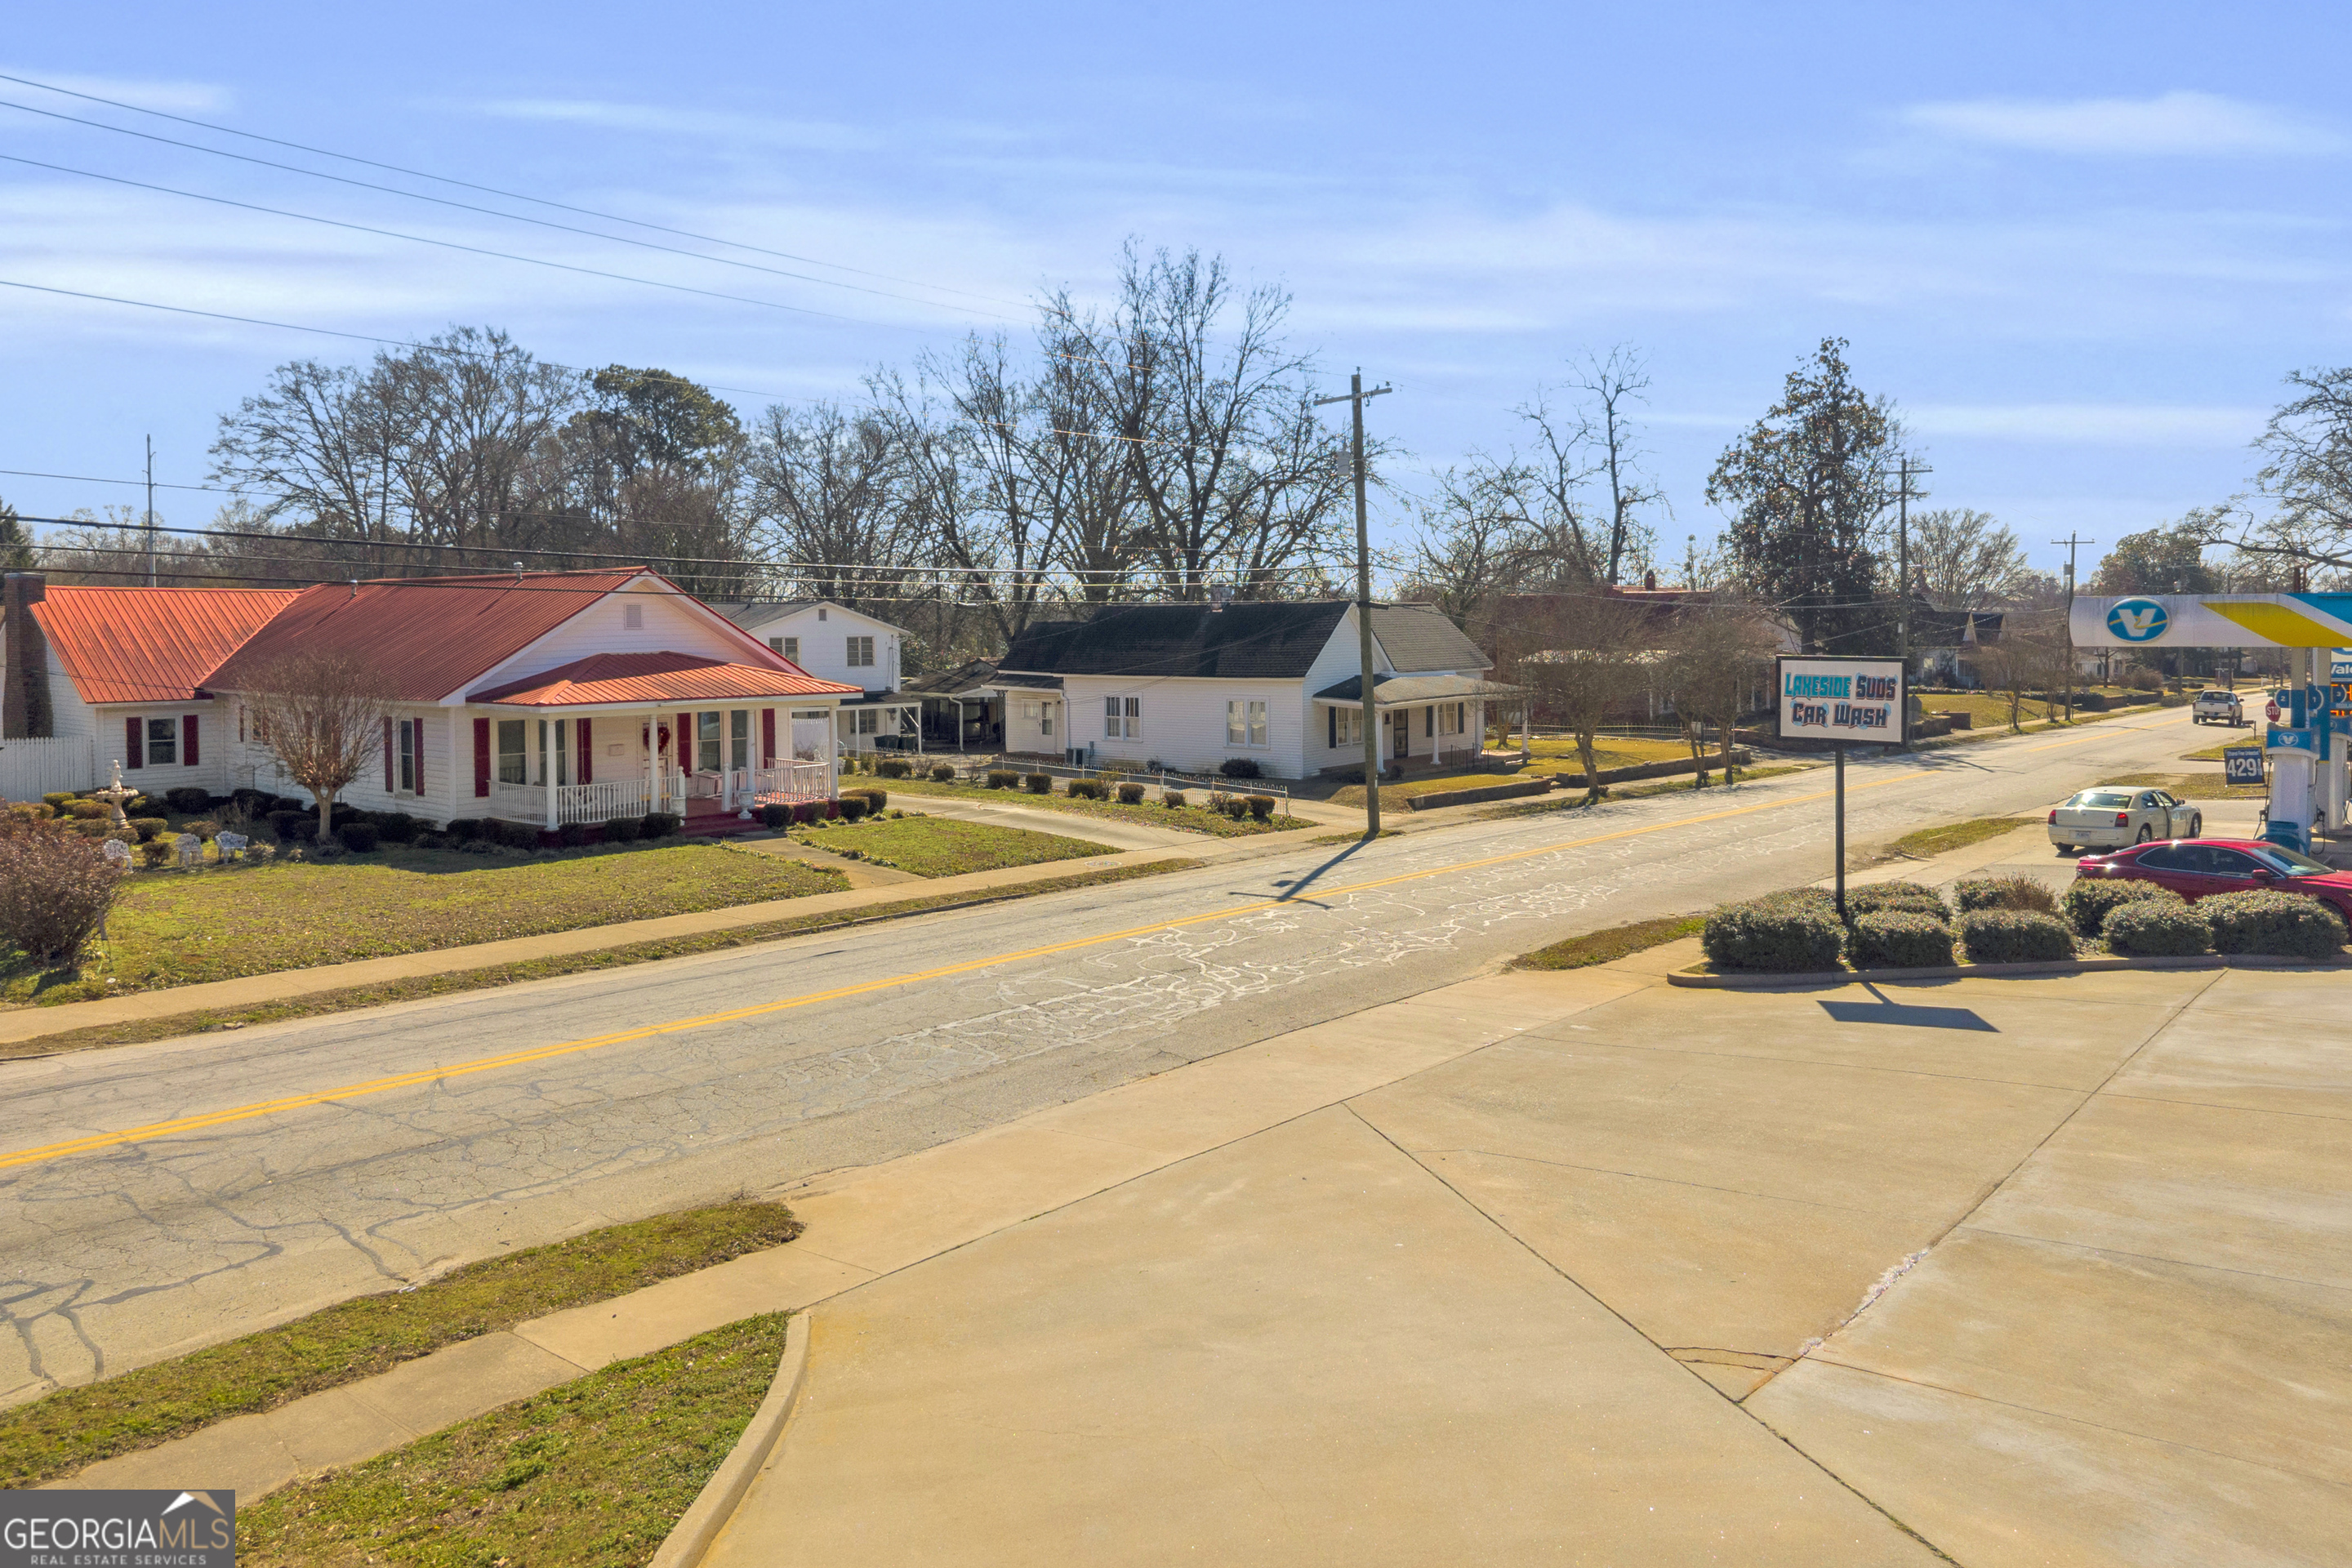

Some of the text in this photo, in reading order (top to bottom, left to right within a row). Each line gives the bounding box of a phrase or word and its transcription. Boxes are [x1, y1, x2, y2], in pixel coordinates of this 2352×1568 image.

[1784, 672, 1898, 701] LAKESIDE SUDS
[1791, 701, 1890, 728] CAR WASH
[2266, 706, 2280, 715] STOP
[2227, 758, 2256, 777] 429
